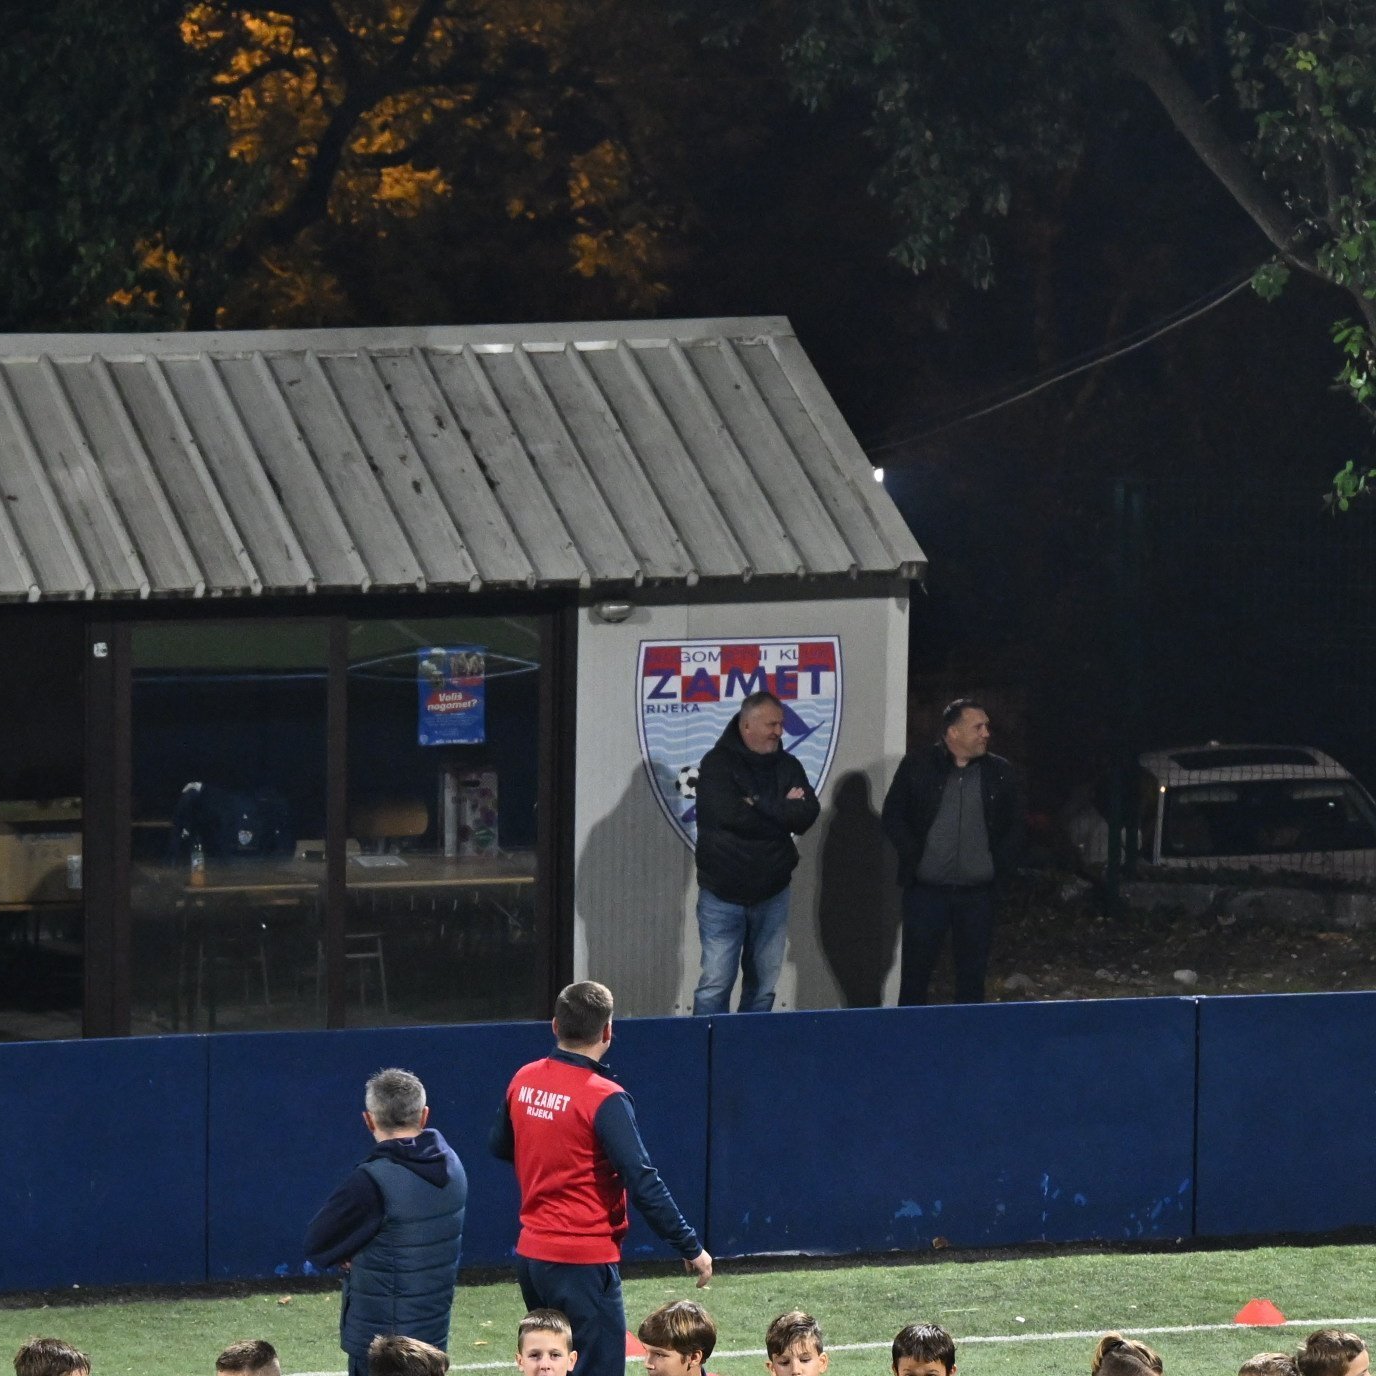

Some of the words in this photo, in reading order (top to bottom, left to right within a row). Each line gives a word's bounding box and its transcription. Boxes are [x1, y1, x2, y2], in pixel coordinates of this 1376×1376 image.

[647, 664, 829, 699] ZAMET
[439, 693, 463, 702] Voliš
[427, 699, 478, 711] nogomet?
[646, 704, 701, 714] RIJEKA
[518, 1086, 534, 1104] NK
[534, 1089, 570, 1111] ZAMET
[526, 1106, 553, 1120] RIJEKA
